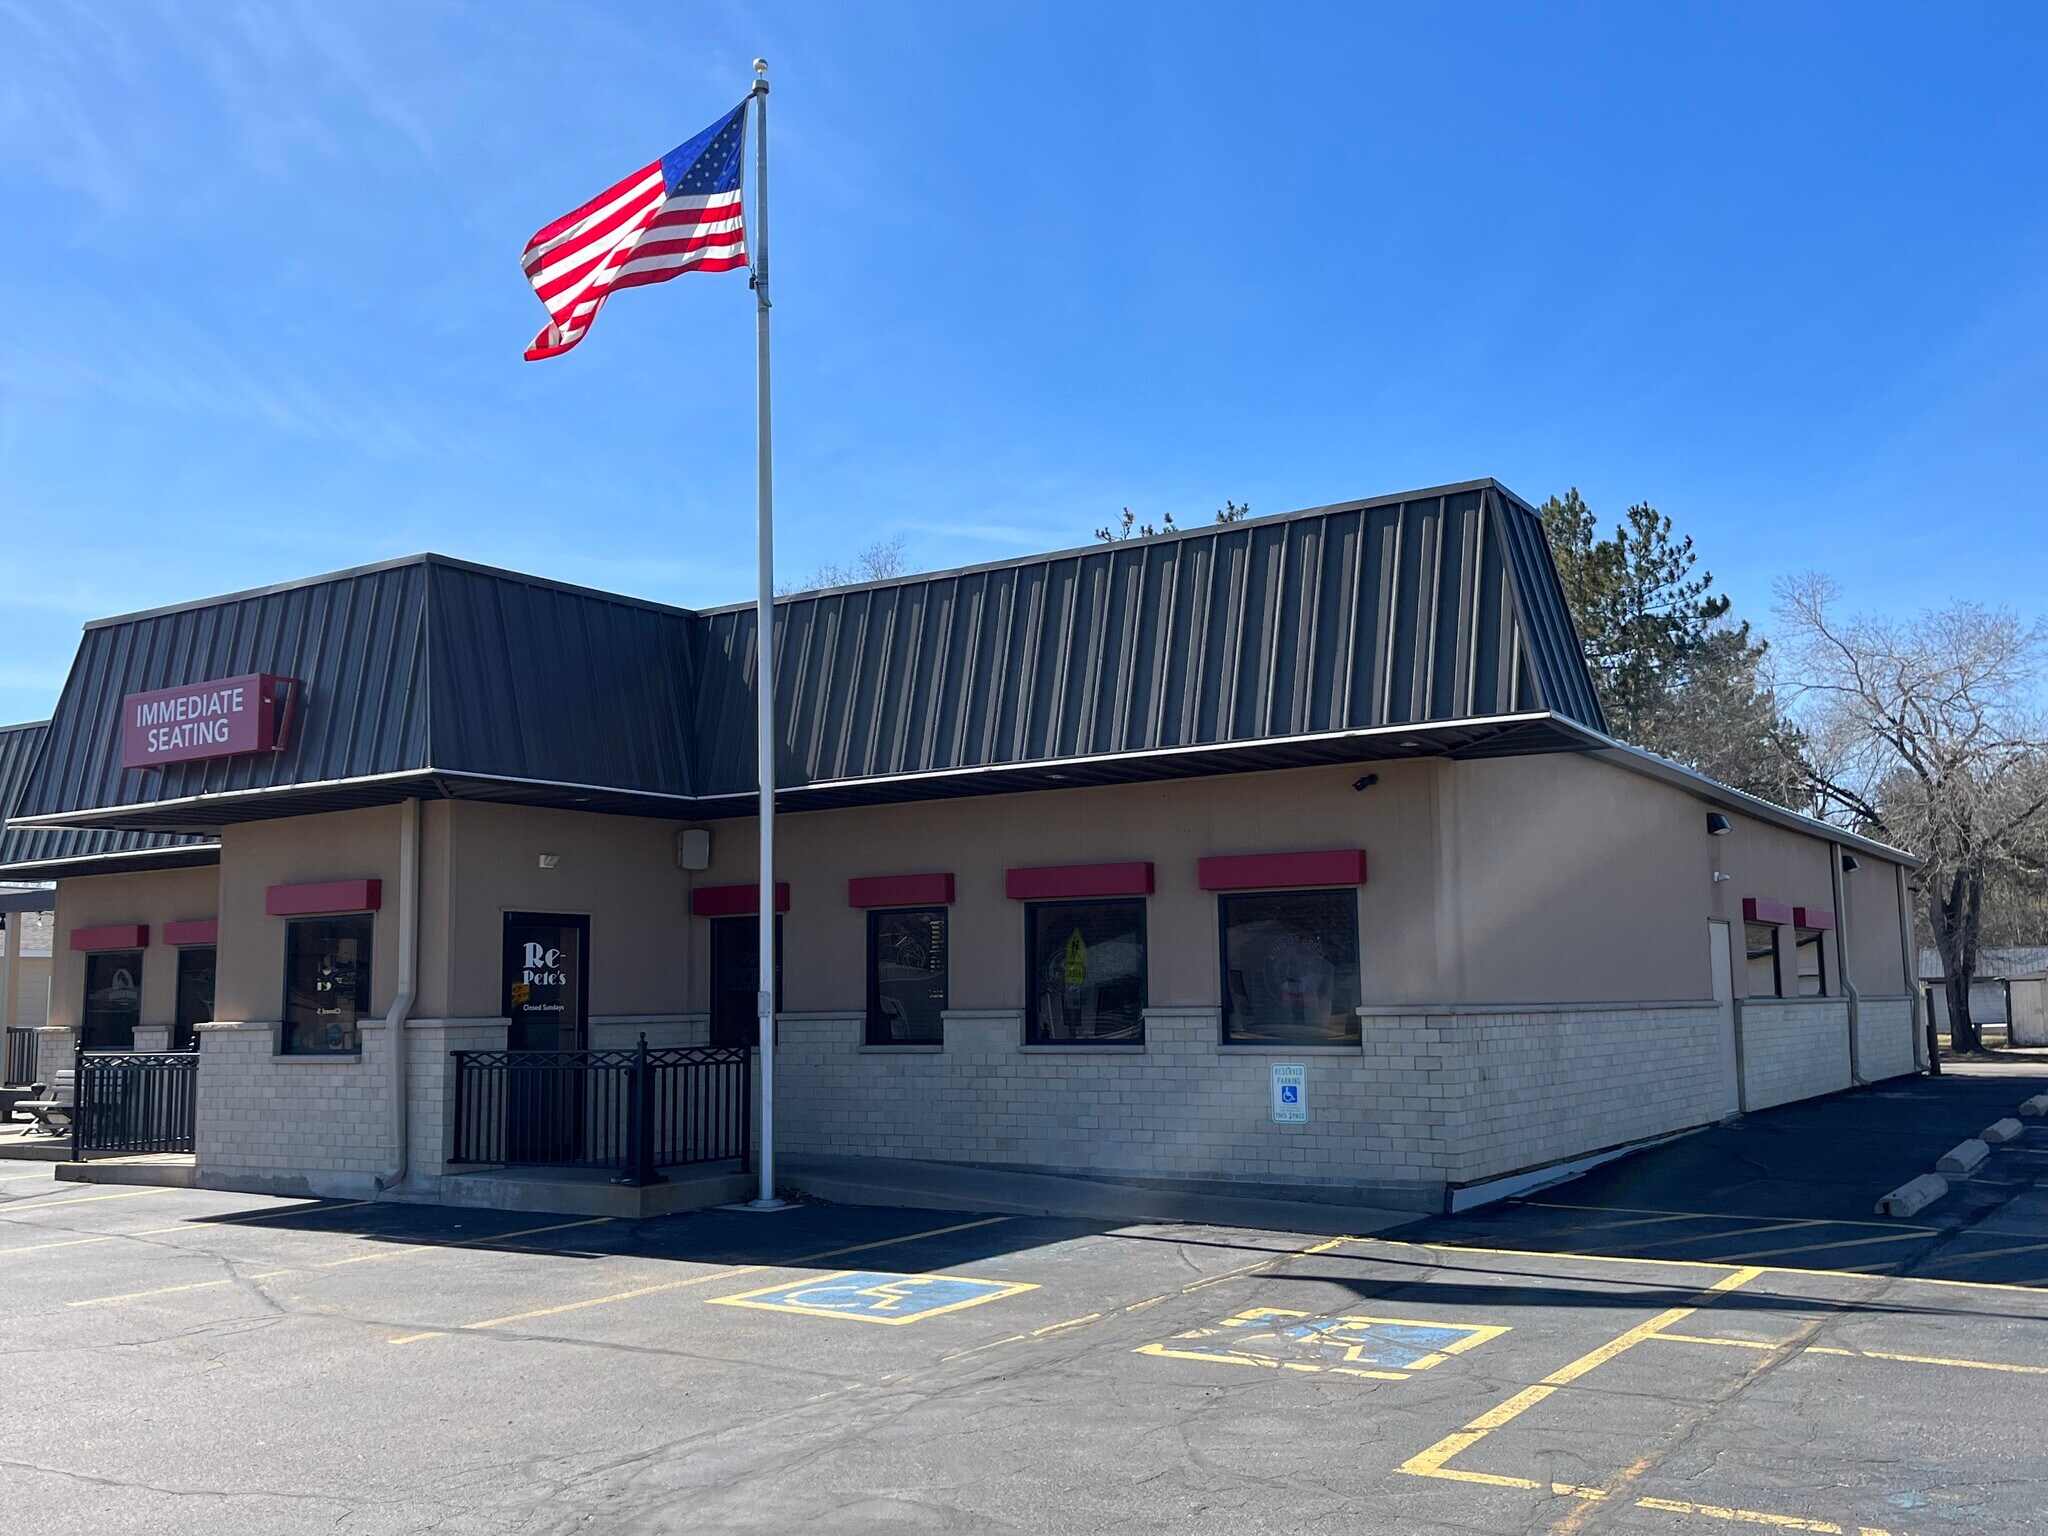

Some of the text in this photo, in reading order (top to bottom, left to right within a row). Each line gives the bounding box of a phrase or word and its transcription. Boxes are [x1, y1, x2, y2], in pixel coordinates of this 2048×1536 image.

[136, 688, 244, 727] IMMEDIATE
[147, 718, 229, 753] SEATING
[522, 970, 566, 985] Pete's
[1275, 1067, 1303, 1076] RESERVED
[1277, 1077, 1301, 1085] PARKING
